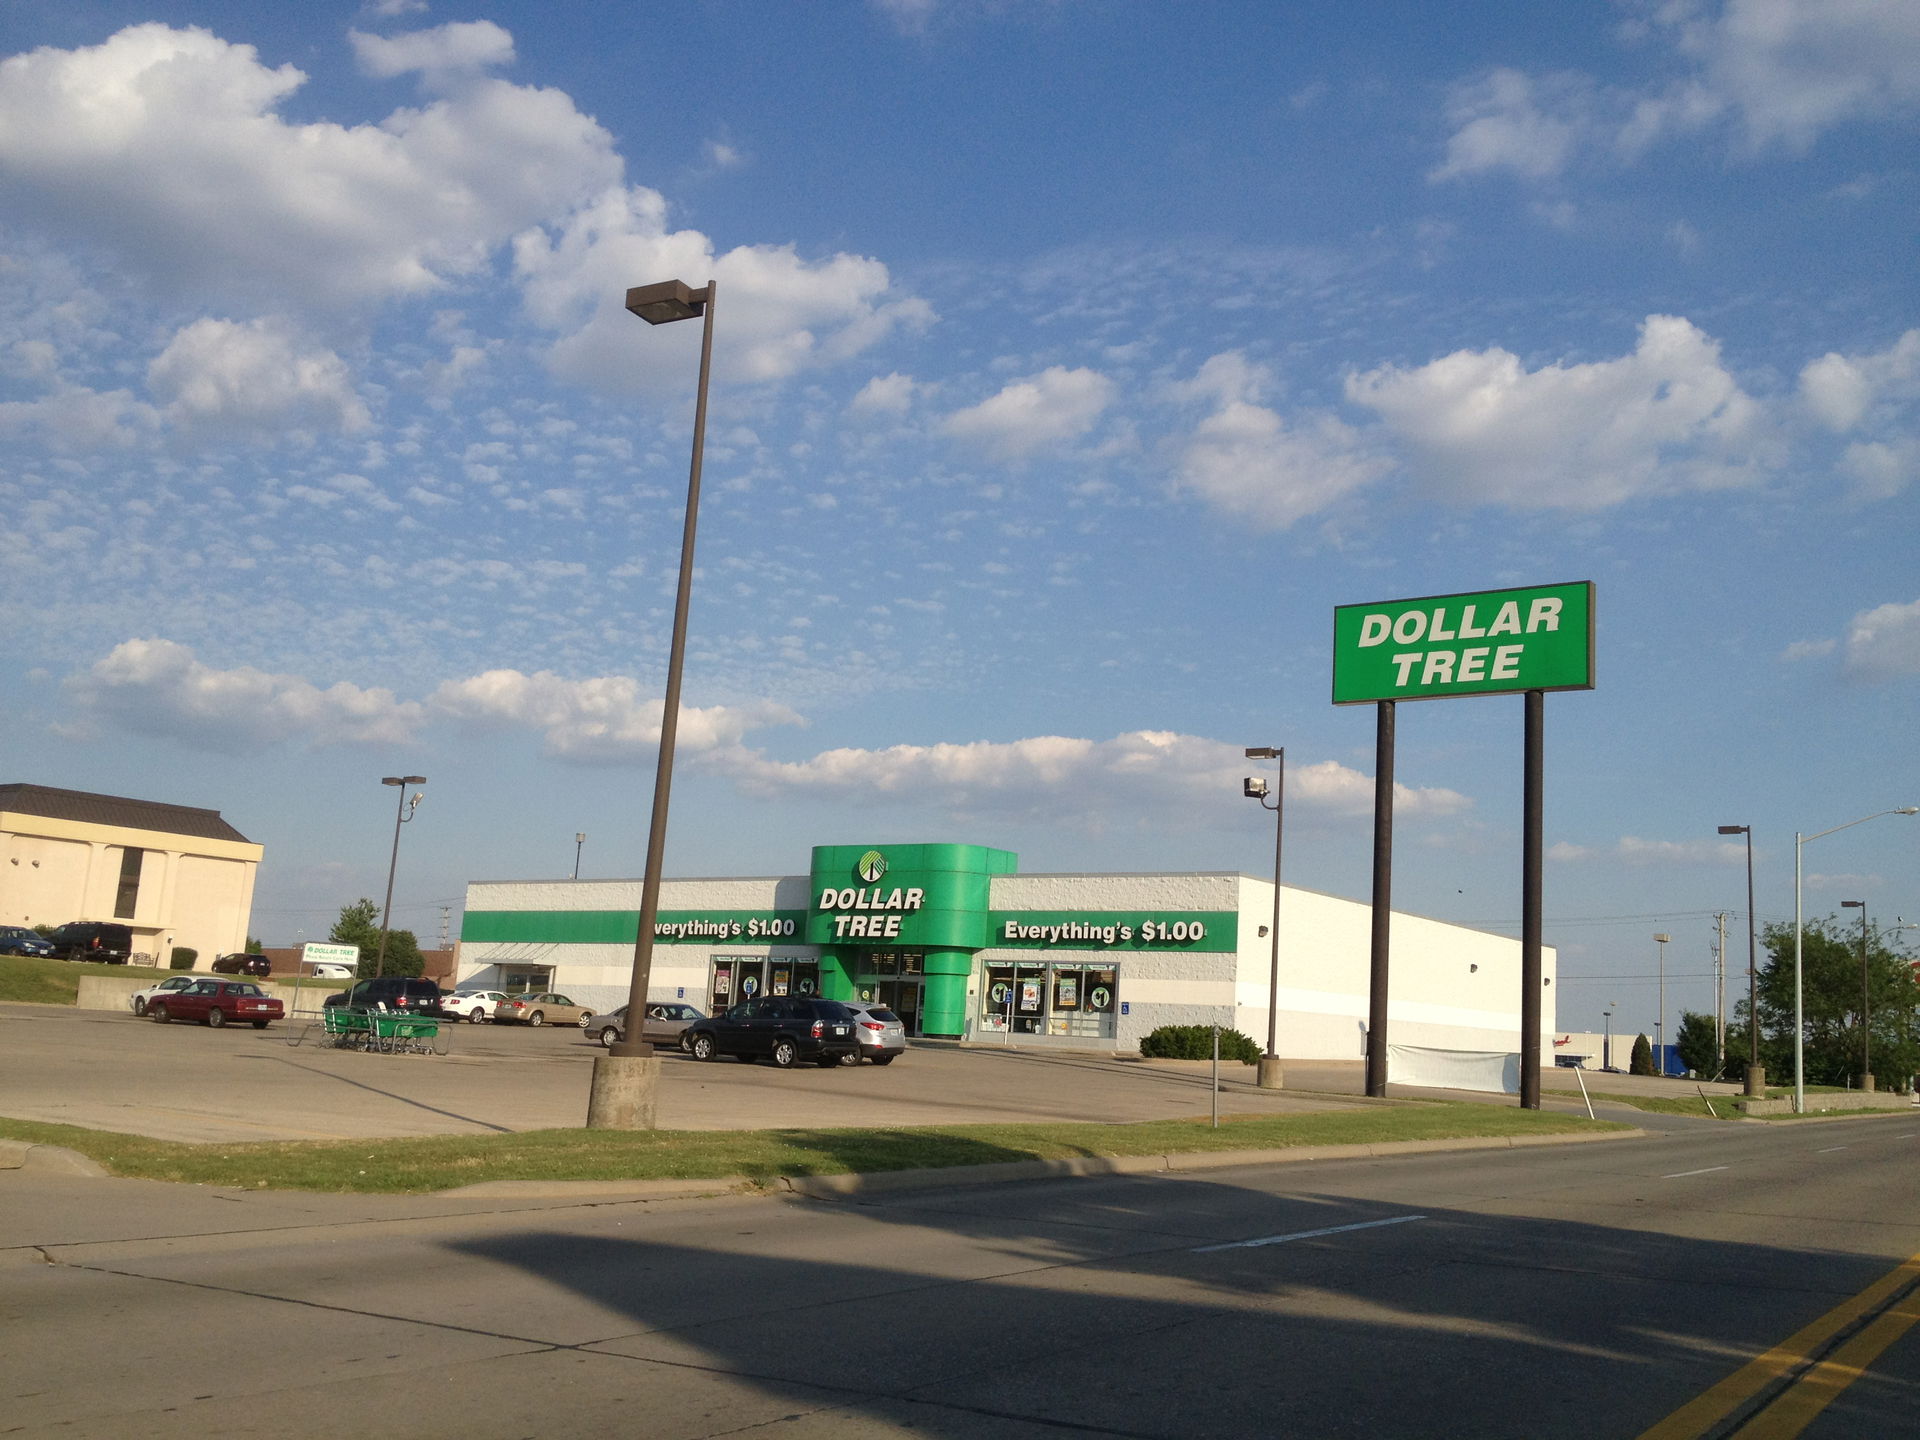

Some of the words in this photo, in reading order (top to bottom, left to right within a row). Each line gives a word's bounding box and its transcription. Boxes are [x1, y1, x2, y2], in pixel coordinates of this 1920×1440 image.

[1358, 597, 1563, 648] DOLLAR
[1391, 644, 1524, 687] TREE
[819, 888, 923, 910] DOLLAR
[654, 918, 741, 938] verything's
[748, 917, 795, 937] $1.00
[834, 915, 902, 937] TREE
[1004, 920, 1132, 943] Everything's
[1141, 919, 1204, 941] $1.00
